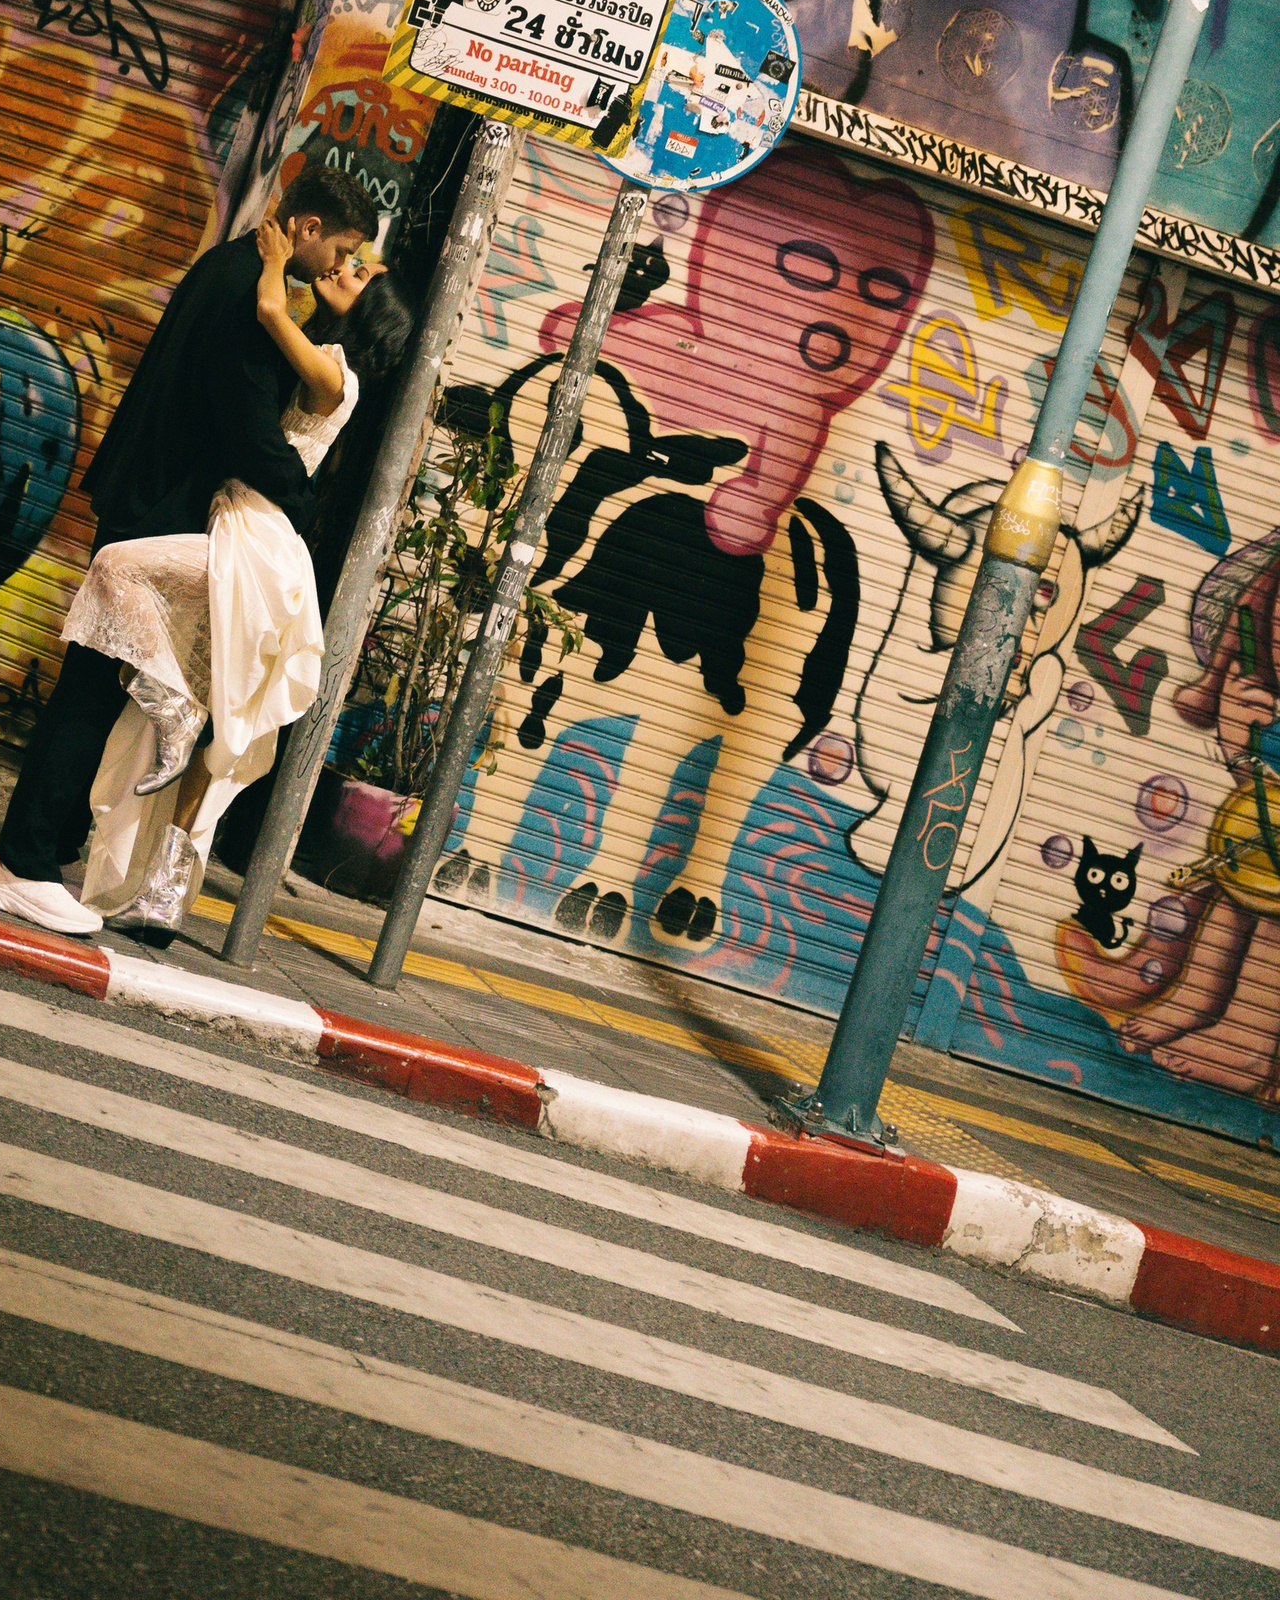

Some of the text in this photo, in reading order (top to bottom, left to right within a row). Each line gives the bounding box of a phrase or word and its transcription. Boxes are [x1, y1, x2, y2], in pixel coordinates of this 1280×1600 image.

[466, 39, 494, 63] No
[495, 52, 575, 93] parking
[504, 5, 645, 73] 24 ชั่วโมง
[490, 78, 517, 95] 3.00
[529, 89, 561, 111] 10.00
[563, 101, 584, 118] P.M.
